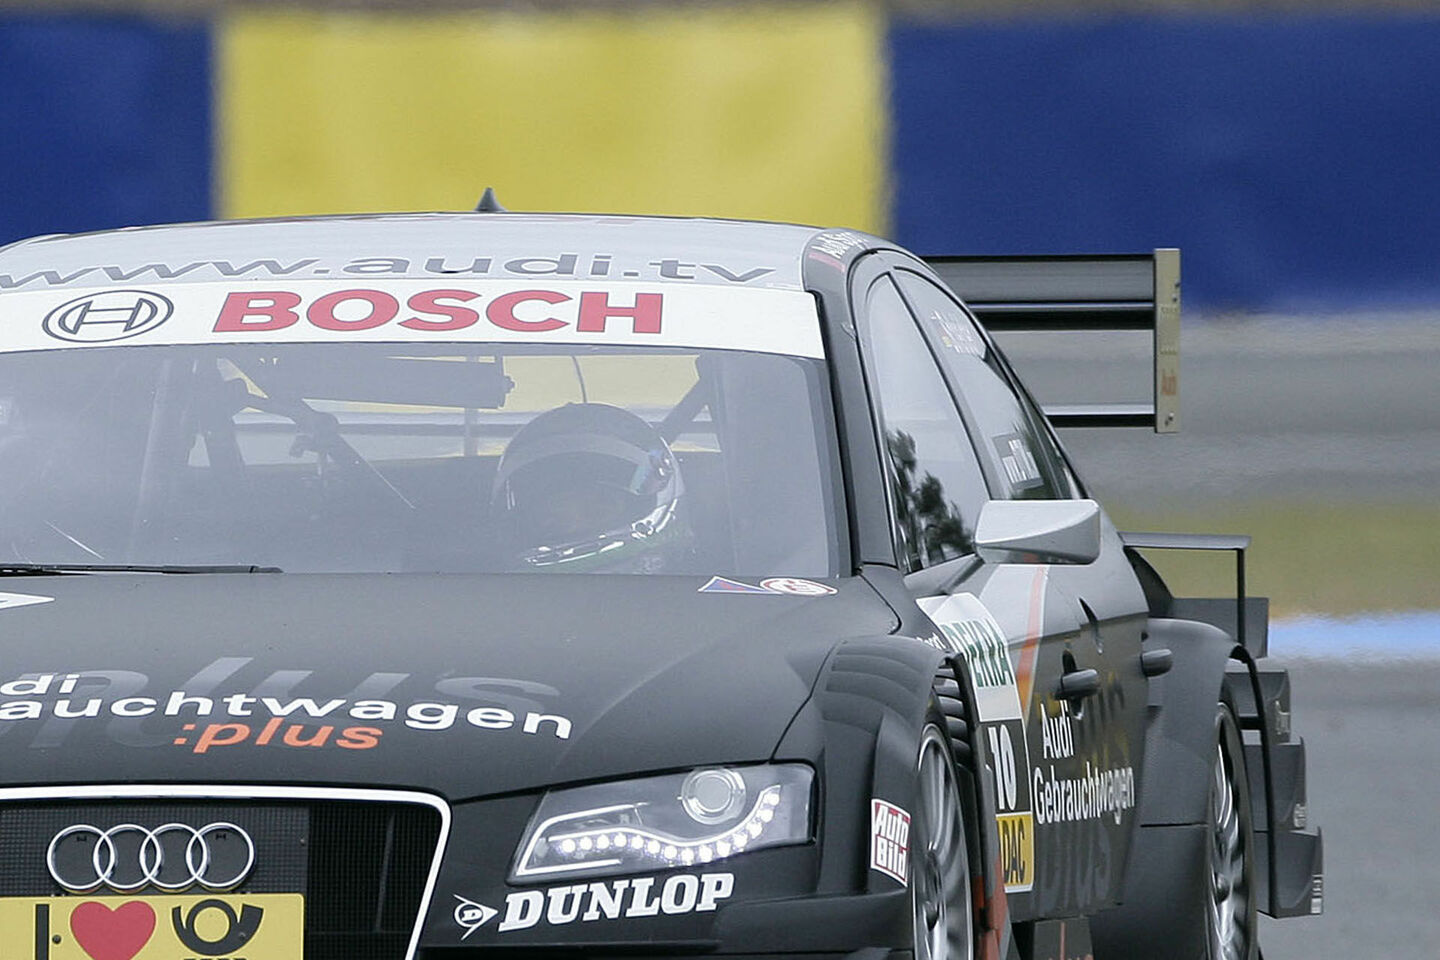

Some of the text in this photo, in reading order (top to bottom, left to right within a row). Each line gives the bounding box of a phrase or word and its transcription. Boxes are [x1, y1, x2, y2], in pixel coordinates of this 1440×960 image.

[211, 289, 664, 334] BOSCH
[172, 716, 384, 755] :plus
[1040, 699, 1075, 760] Audi
[987, 723, 1018, 811] 10
[1033, 760, 1136, 826] Gebrauchtwagen
[876, 803, 910, 851] Auto
[1002, 817, 1026, 885] DAC
[876, 836, 909, 881] Bild
[498, 872, 736, 933] DUNLOP
